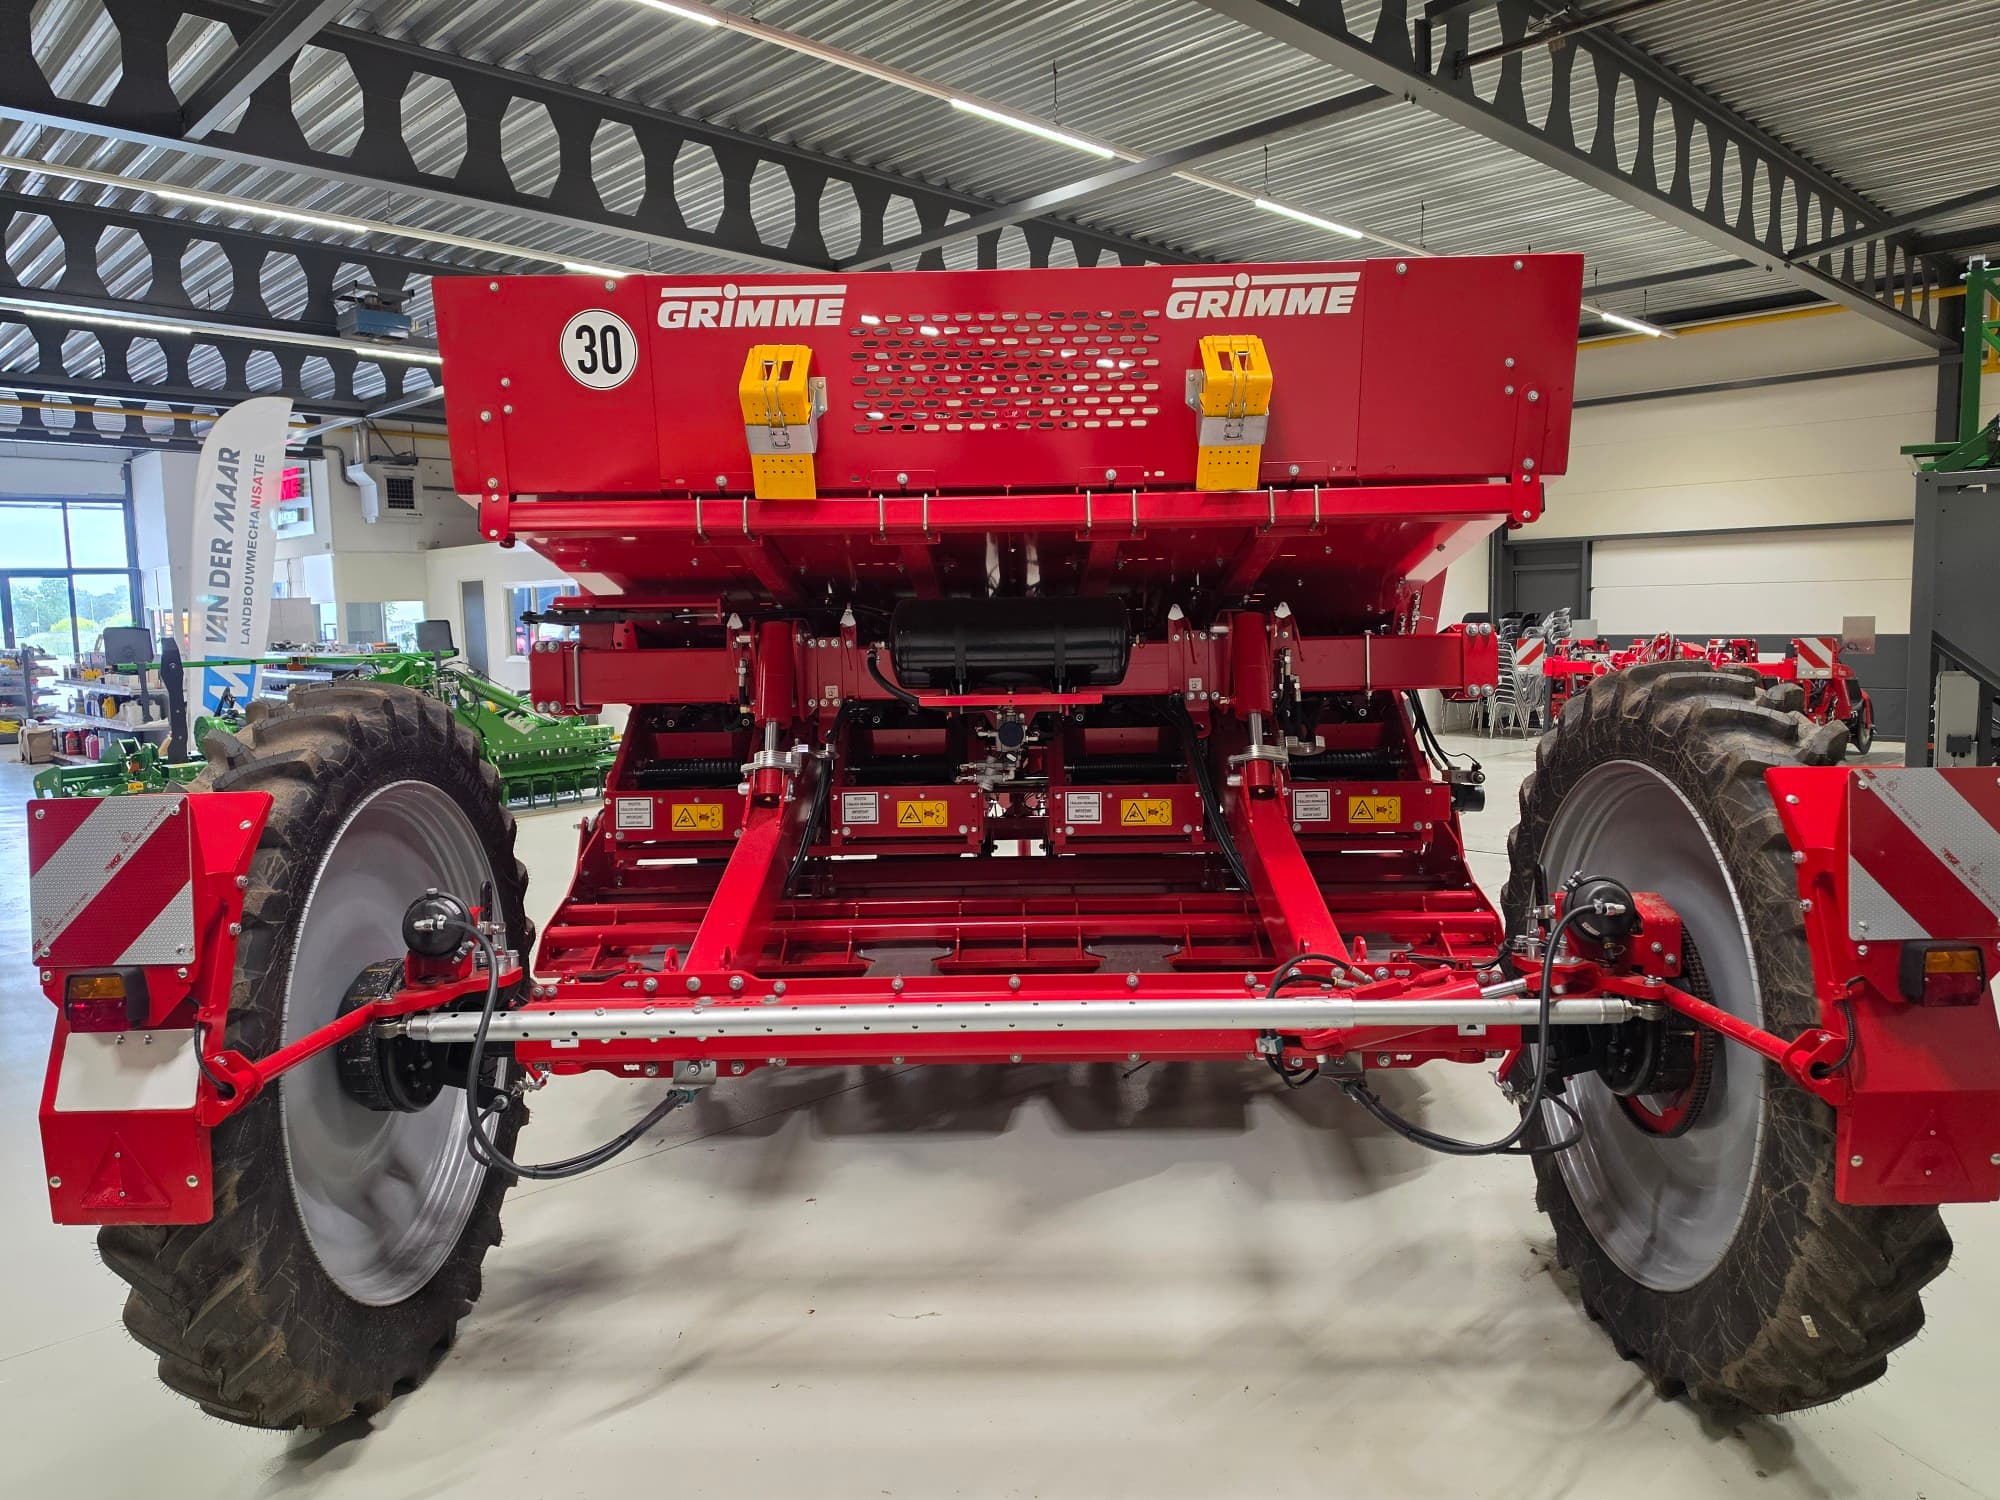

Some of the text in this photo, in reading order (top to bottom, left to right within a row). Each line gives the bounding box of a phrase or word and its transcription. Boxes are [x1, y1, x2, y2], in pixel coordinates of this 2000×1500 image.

[657, 284, 845, 329] GRIMME
[1166, 272, 1357, 319] GRIMME
[574, 324, 623, 376] 30
[205, 447, 241, 643] VAN DER MAAR
[241, 453, 265, 645] LANDBOUWMECHANISATIE
